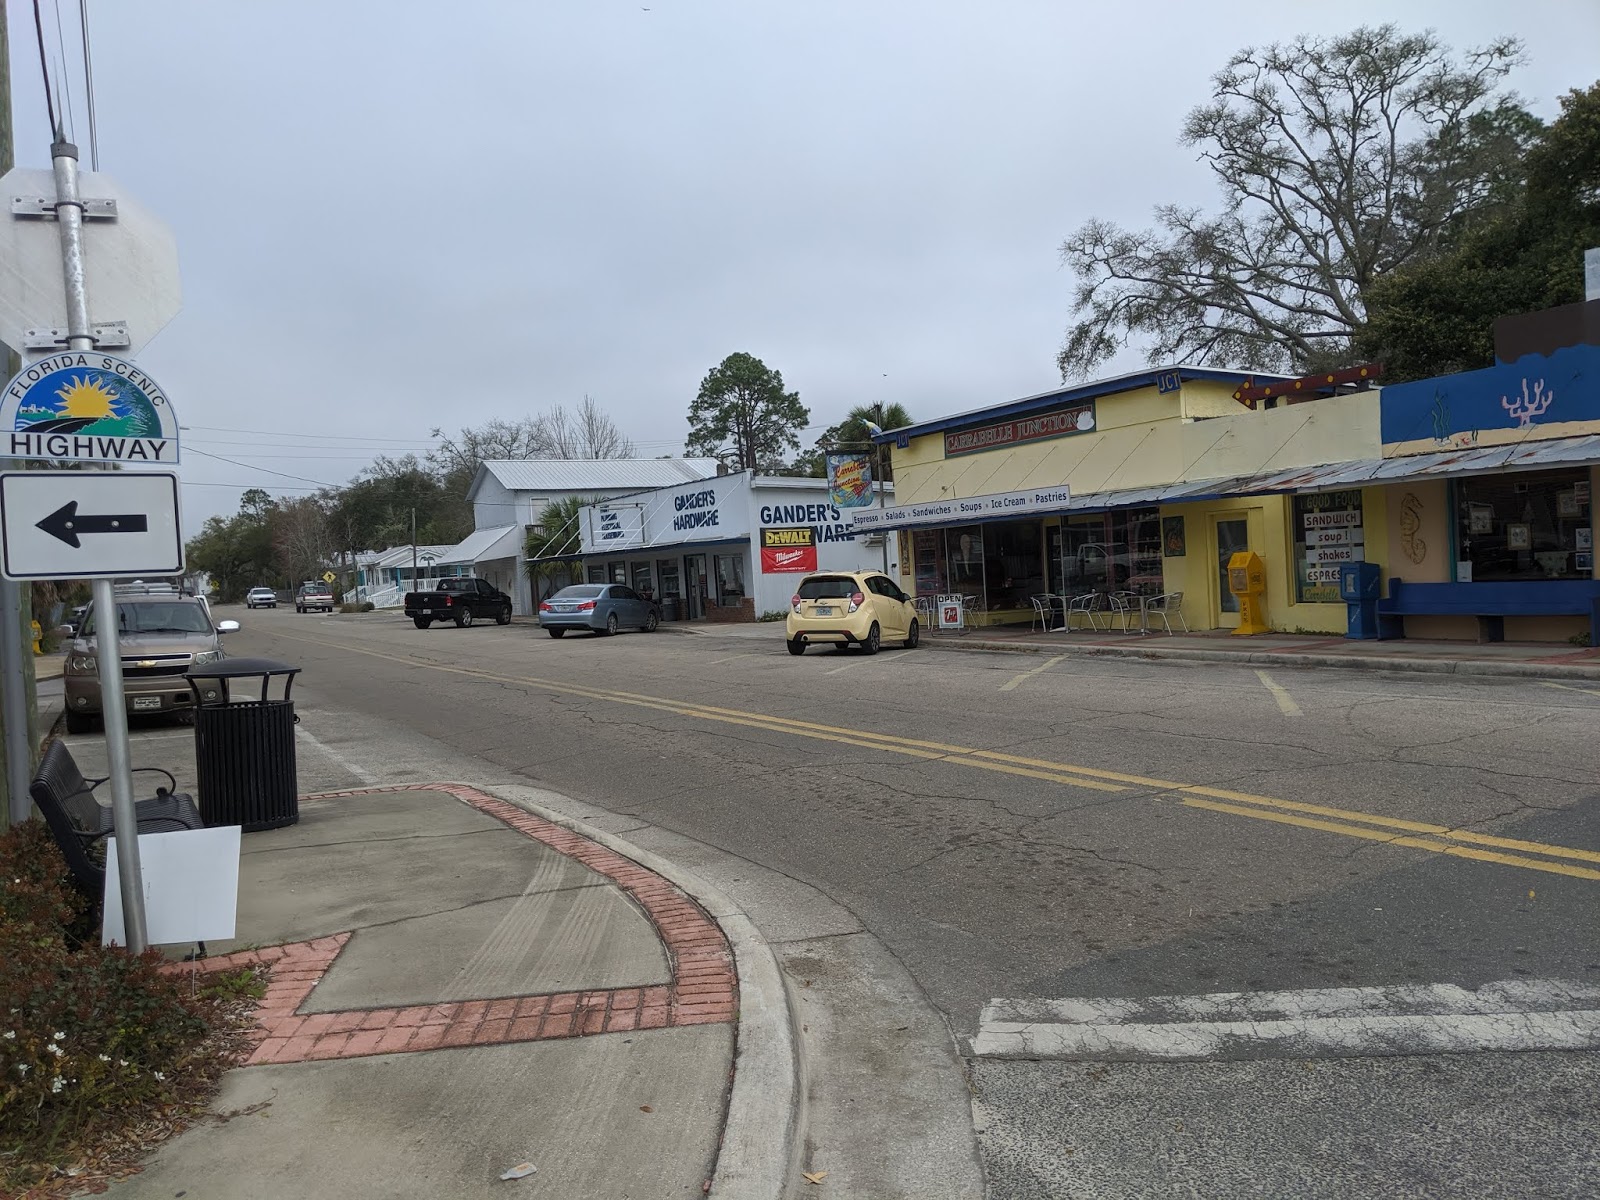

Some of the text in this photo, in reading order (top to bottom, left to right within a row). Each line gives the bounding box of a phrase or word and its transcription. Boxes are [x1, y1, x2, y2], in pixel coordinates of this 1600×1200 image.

[10, 355, 165, 407] FLORIDA SCENIC
[1160, 373, 1178, 391] JCT
[946, 411, 1079, 450] CARRABELLE JUNCTION
[11, 433, 168, 461] HIGHWAY
[674, 489, 716, 511] GANDER'S
[853, 492, 1067, 524] Espresso Salads Sandwiches Soups Ice Cream Pastries
[1307, 491, 1361, 509] GOOD FOOD
[673, 509, 719, 531] HARDWARE
[760, 503, 841, 524] GANDER'S
[1306, 513, 1357, 526] SANDWICH
[1318, 550, 1351, 561] shakes
[1307, 569, 1341, 581] ESPRES
[938, 595, 962, 603] OPEN
